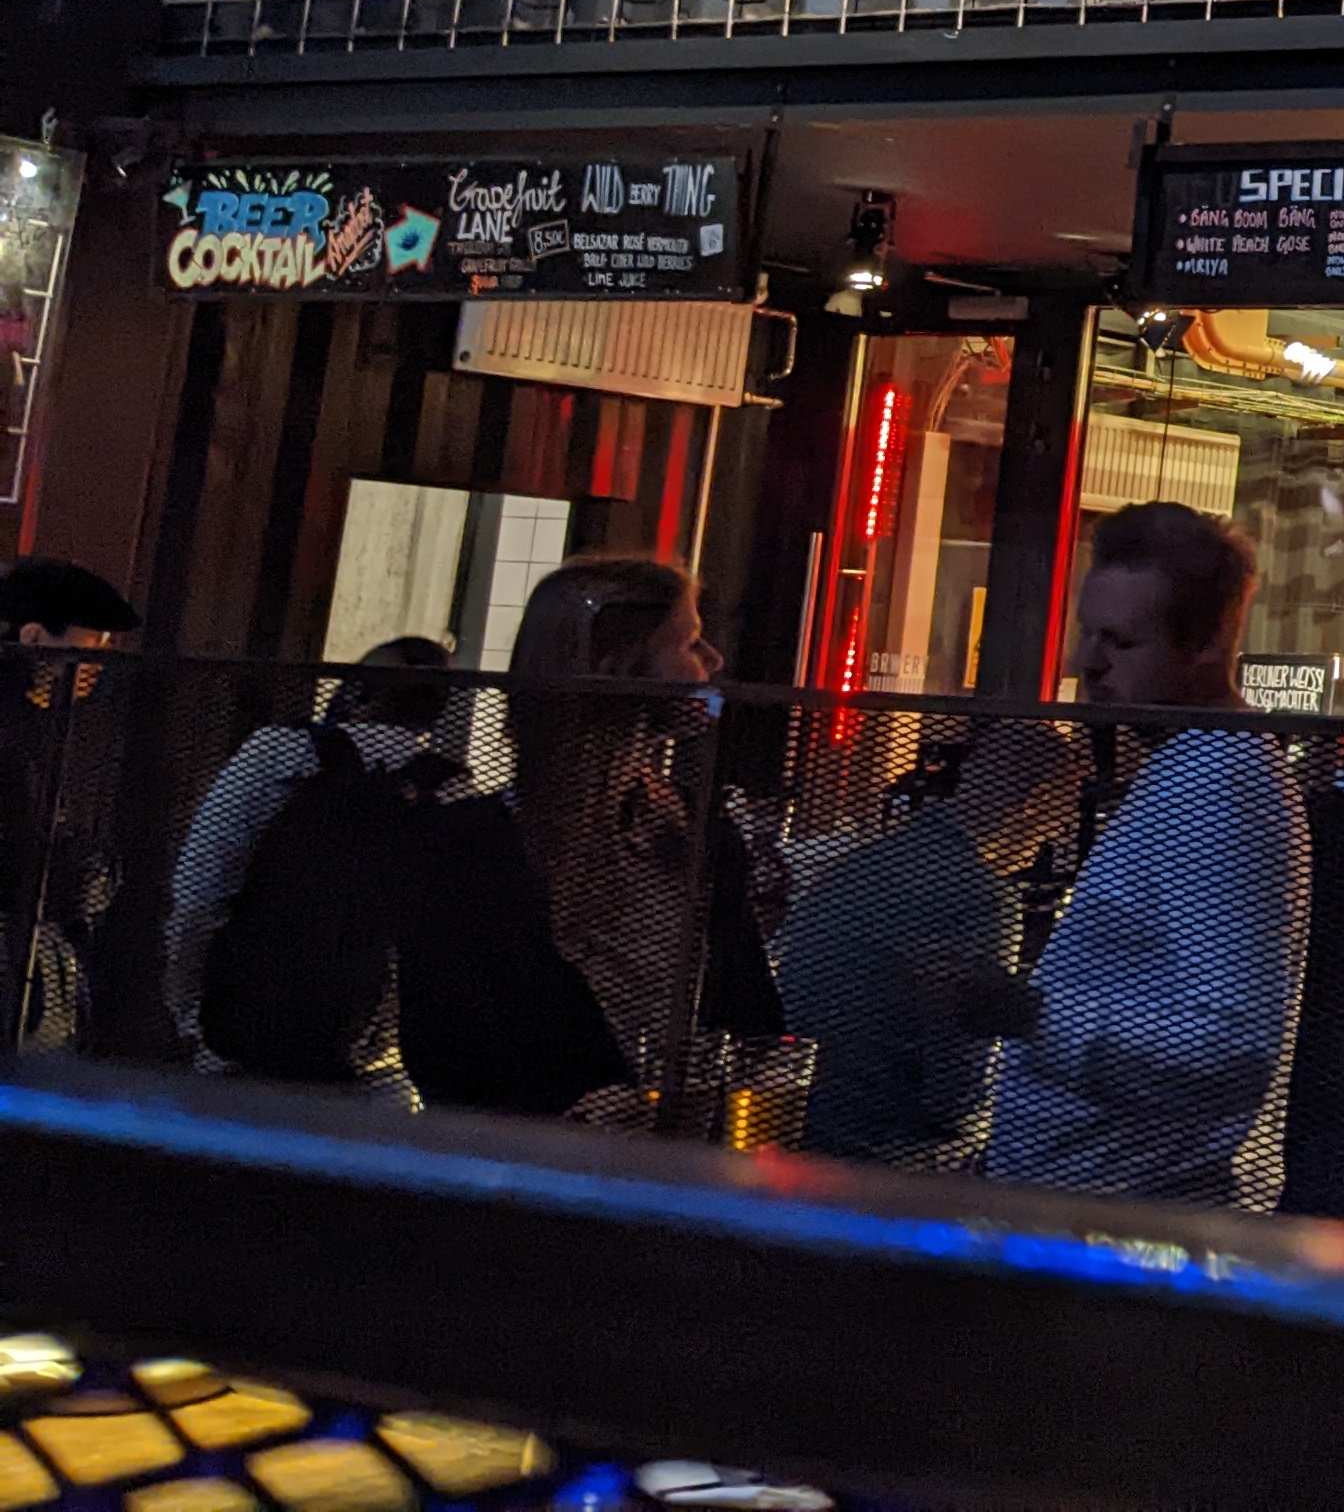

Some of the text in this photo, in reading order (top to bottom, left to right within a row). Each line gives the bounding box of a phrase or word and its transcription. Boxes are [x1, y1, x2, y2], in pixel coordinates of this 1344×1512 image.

[196, 191, 330, 253] BEER
[449, 168, 567, 229] Grapefruit
[457, 211, 514, 243] LANE
[1234, 209, 1268, 229] BOOM
[168, 228, 327, 288] COCKTAIL
